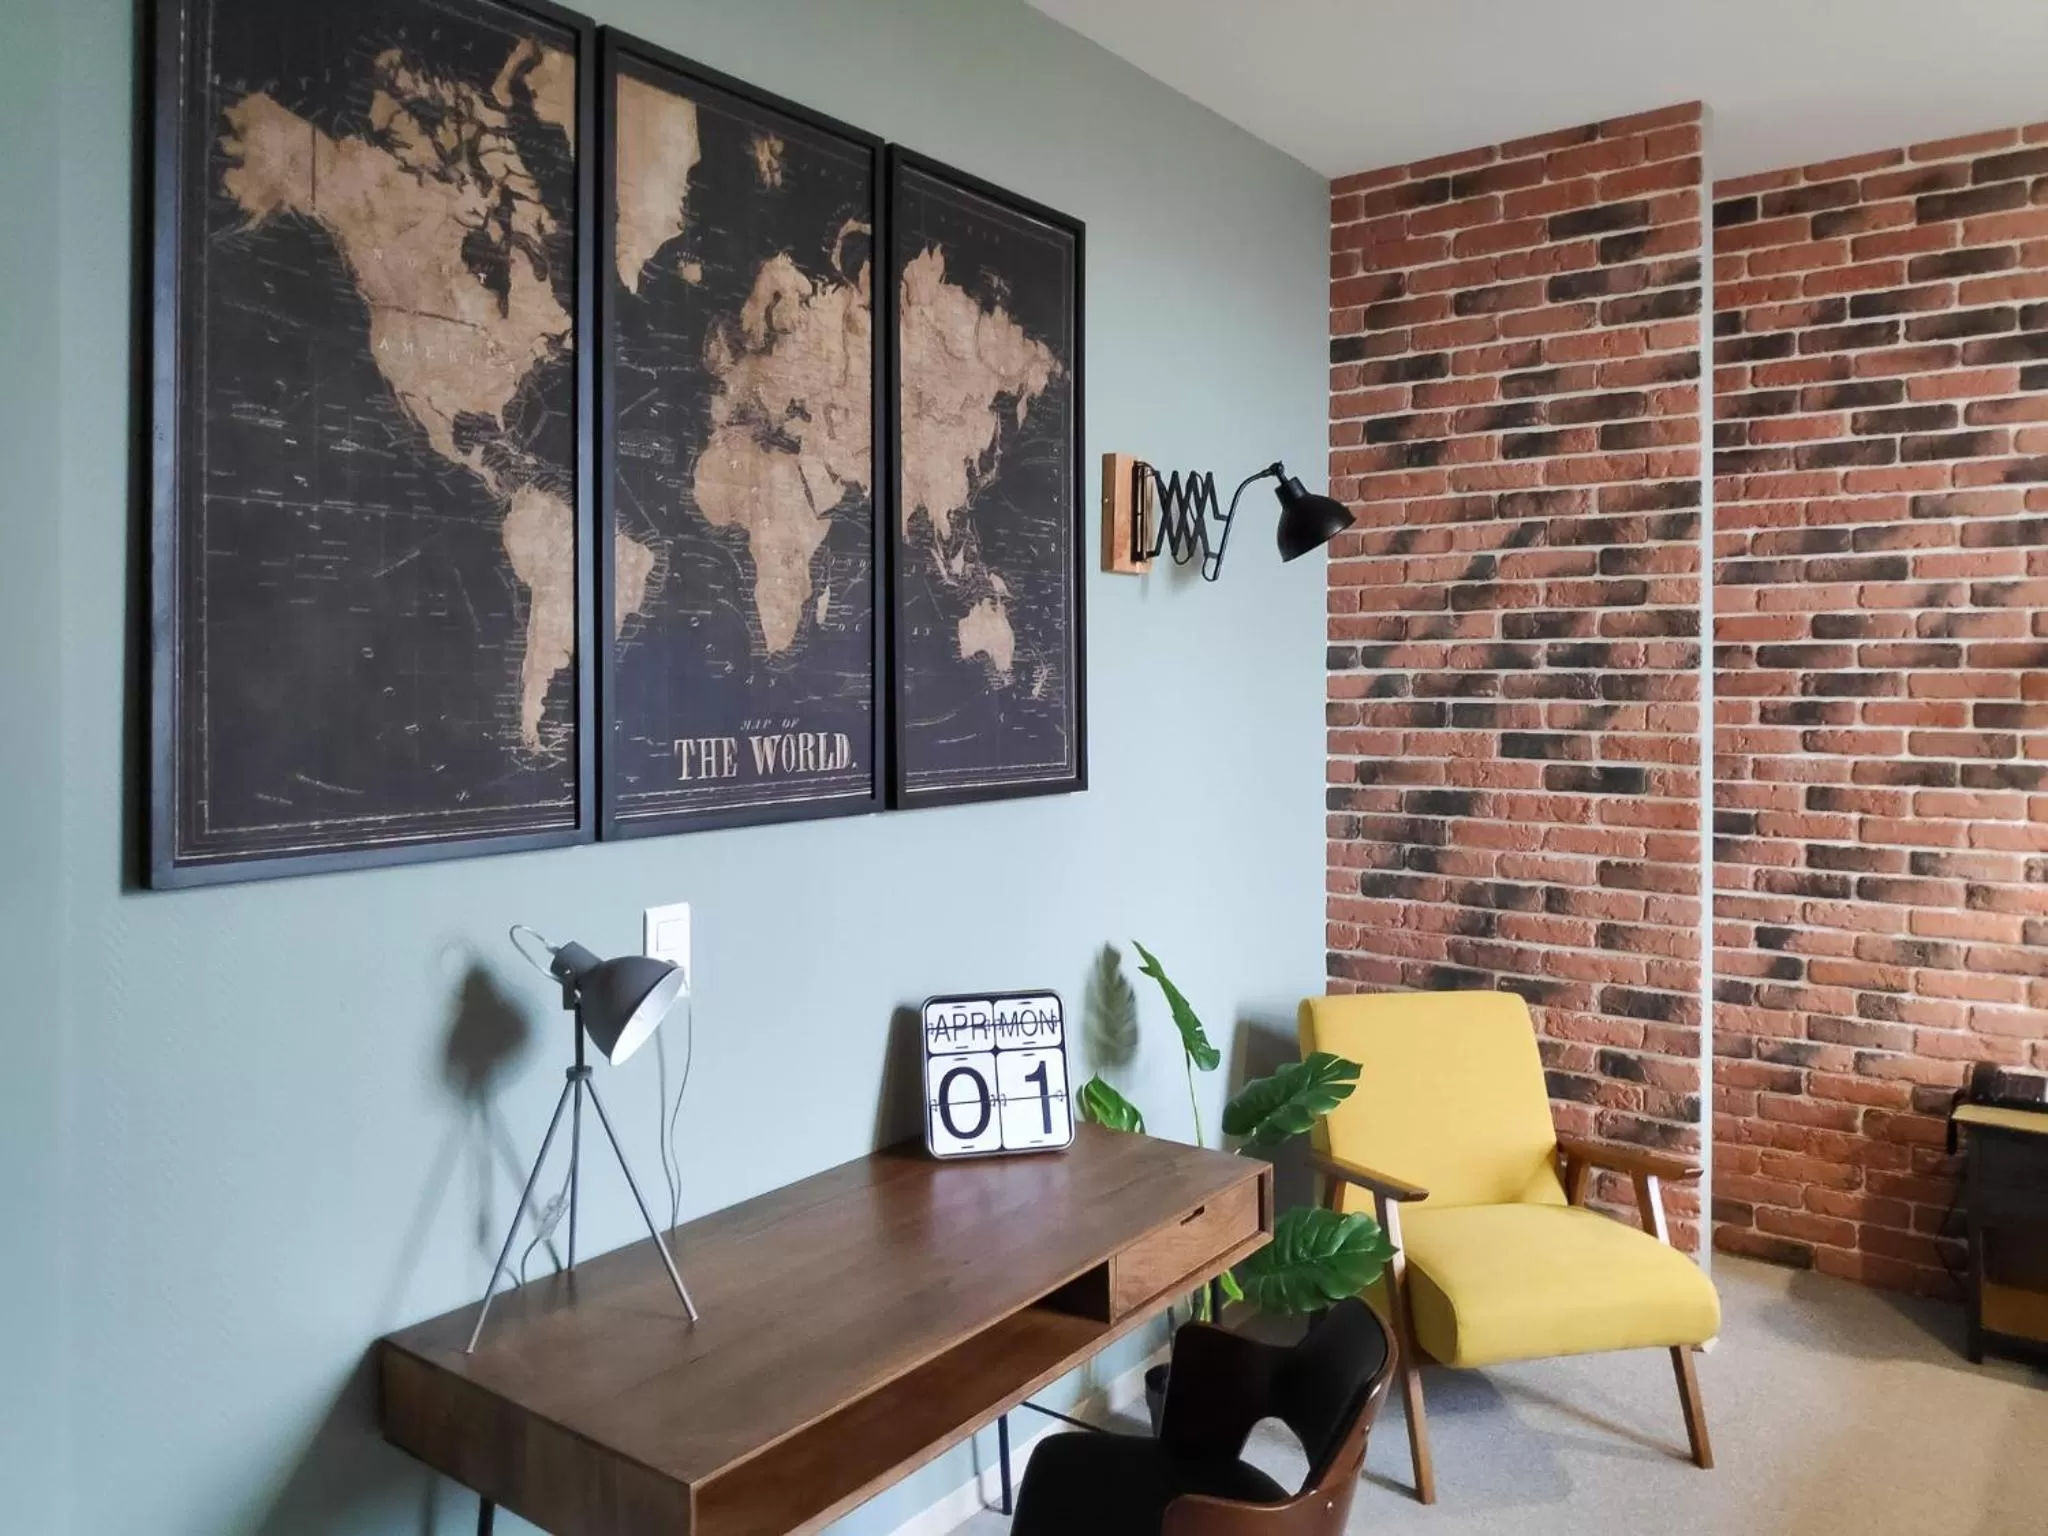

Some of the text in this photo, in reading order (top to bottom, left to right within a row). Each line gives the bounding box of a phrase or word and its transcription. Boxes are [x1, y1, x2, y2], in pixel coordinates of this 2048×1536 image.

[674, 731, 857, 781] THE WORLD.
[934, 1008, 1056, 1043] APR MON
